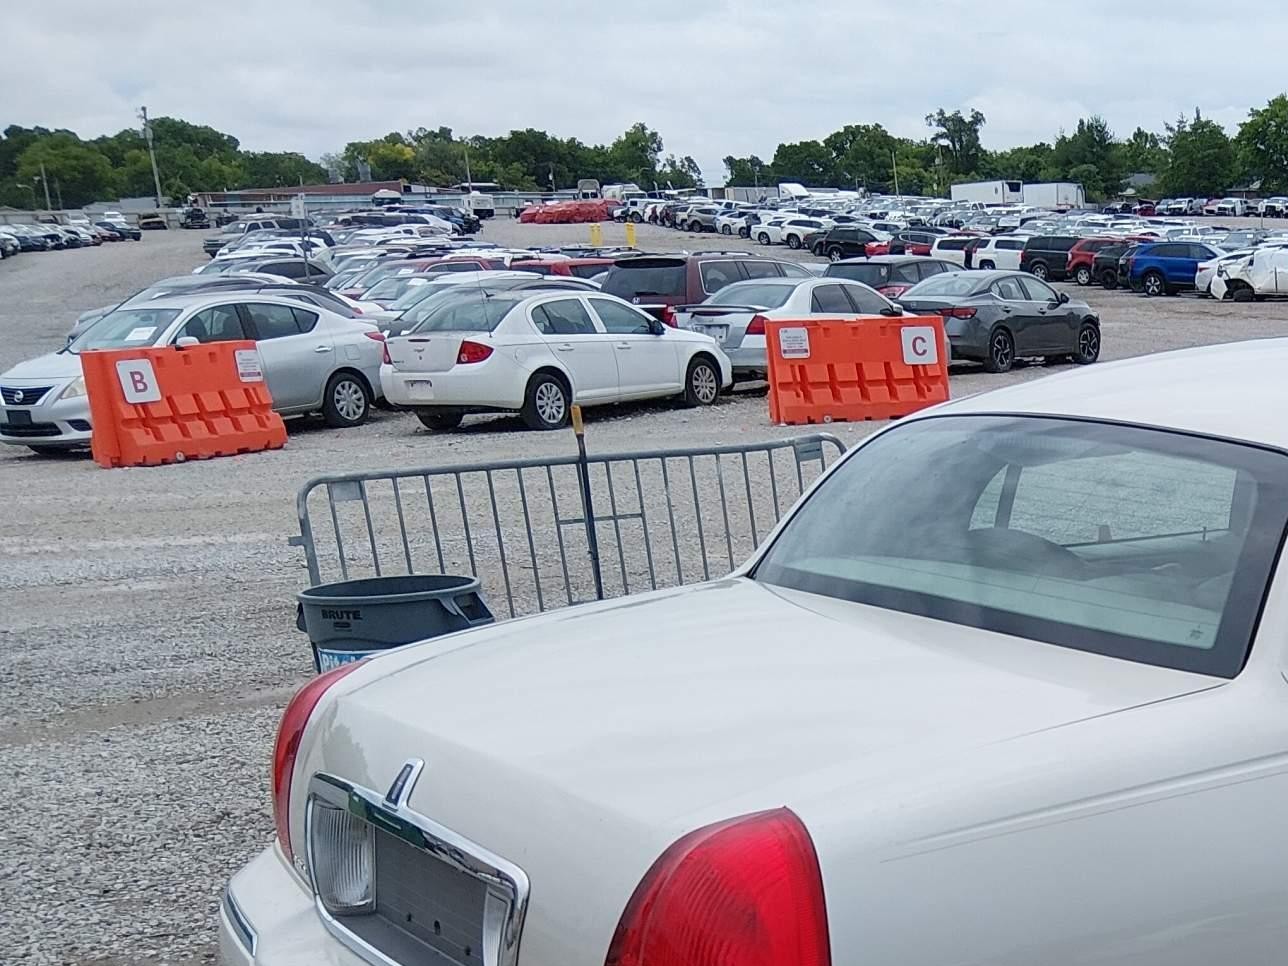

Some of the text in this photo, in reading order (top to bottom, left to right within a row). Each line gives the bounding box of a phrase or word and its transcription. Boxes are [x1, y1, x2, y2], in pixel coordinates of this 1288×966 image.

[911, 336, 927, 357] C
[129, 371, 148, 394] B
[321, 609, 363, 621] BRUTE
